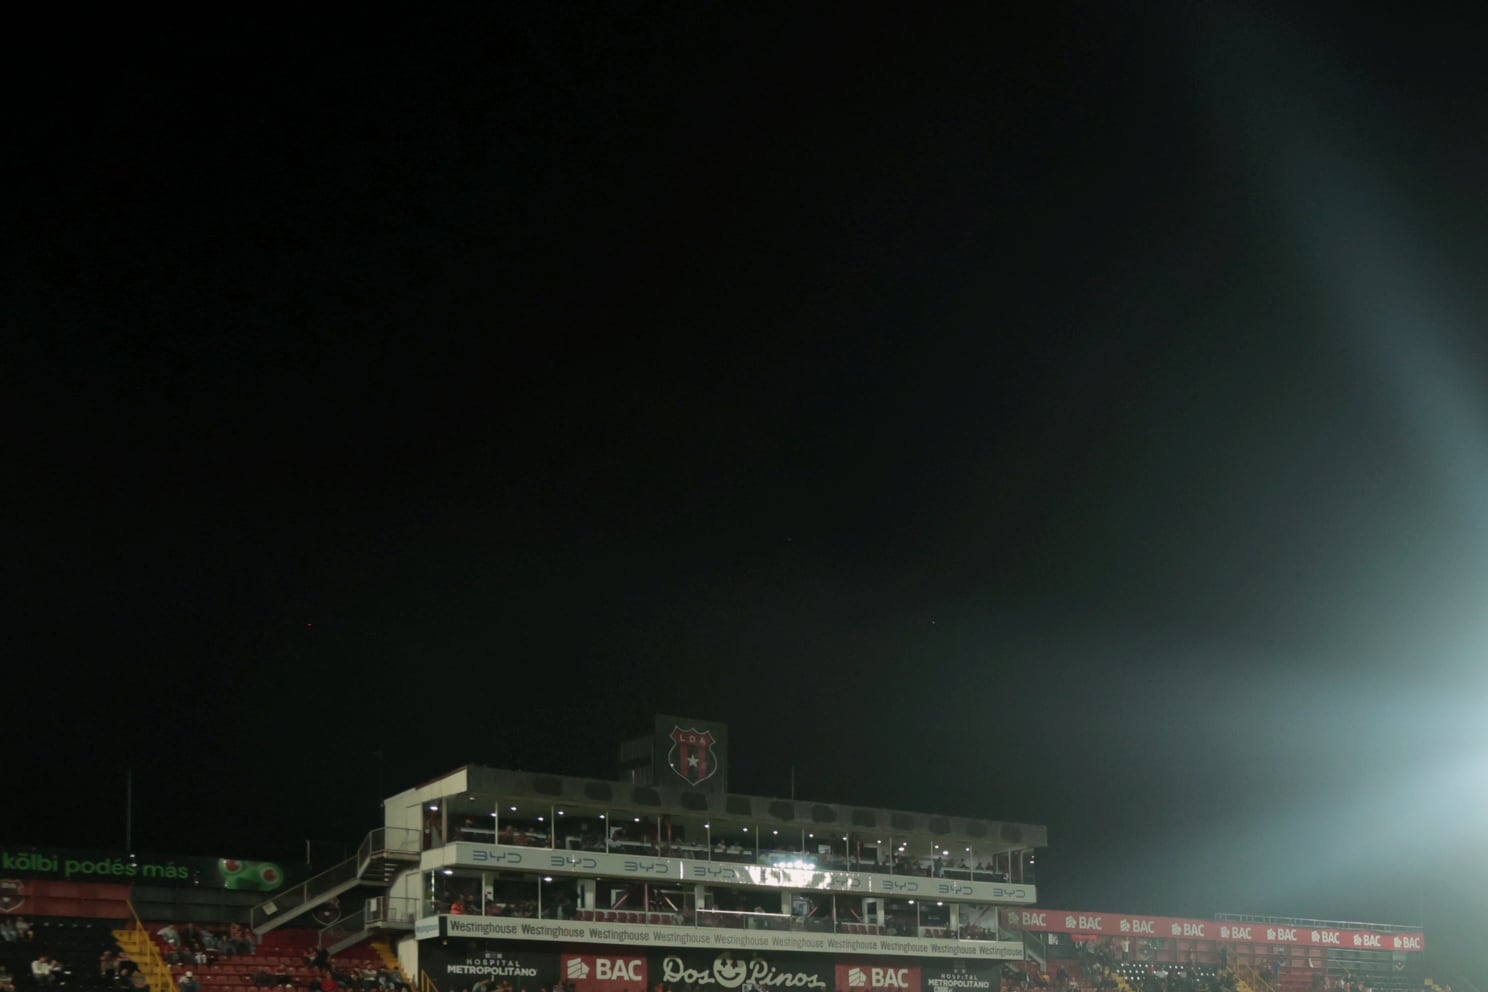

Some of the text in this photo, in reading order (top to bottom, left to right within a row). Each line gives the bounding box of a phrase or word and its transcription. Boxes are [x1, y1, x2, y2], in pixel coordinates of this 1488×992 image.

[472, 850, 522, 863] BYD
[551, 856, 597, 869] BYD
[65, 858, 136, 877] podés
[142, 863, 189, 879] más
[624, 861, 670, 873] BYD
[883, 881, 918, 891] BYD
[939, 884, 973, 895] BYD
[993, 888, 1026, 898] BYD
[1022, 912, 1046, 926] BAC
[1079, 916, 1102, 930] BAC
[451, 919, 517, 935] Westinghouse
[521, 924, 585, 938] Westinghouse
[1132, 920, 1155, 933] BAC
[1183, 923, 1205, 937] BAC
[1232, 926, 1252, 940] BAC
[589, 928, 649, 941] Westinghouse
[654, 931, 710, 945] Westinghouse
[714, 934, 768, 947] Westinghouse
[1277, 929, 1297, 941] BAC
[1322, 931, 1340, 944] BAC
[1363, 934, 1381, 947] BAC
[772, 937, 824, 949] Westinghouse
[827, 939, 877, 951] Westinghouse
[880, 941, 928, 953] Westinghouse
[931, 944, 976, 955] Westinghouse
[1403, 937, 1421, 949] BAC
[979, 946, 1022, 957] Westinghouse
[466, 958, 520, 967] HOSPITAL
[447, 965, 537, 977] METROPOLITANO
[596, 960, 642, 981] BAC
[663, 957, 825, 987] Dos Pinos
[872, 969, 908, 987] BAC
[928, 978, 989, 988] METROPOLITANO
